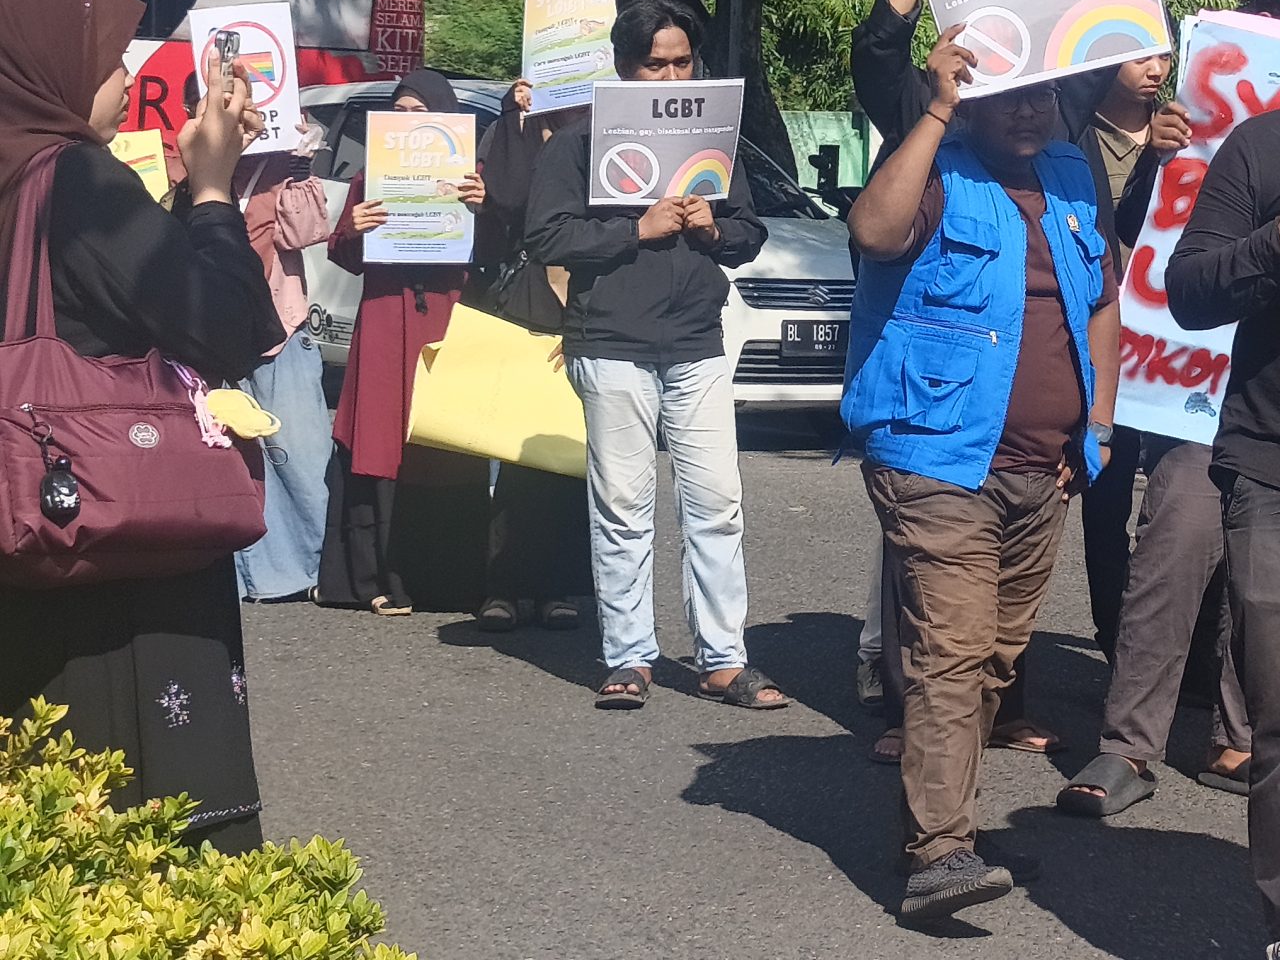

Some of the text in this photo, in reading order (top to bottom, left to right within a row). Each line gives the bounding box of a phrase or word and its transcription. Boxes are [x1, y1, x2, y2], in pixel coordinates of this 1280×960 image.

[376, 12, 423, 28] SELAM
[651, 98, 706, 119] LGBT
[384, 131, 435, 151] STOP
[400, 152, 445, 169] LGBT
[787, 324, 839, 341] BL 1857
